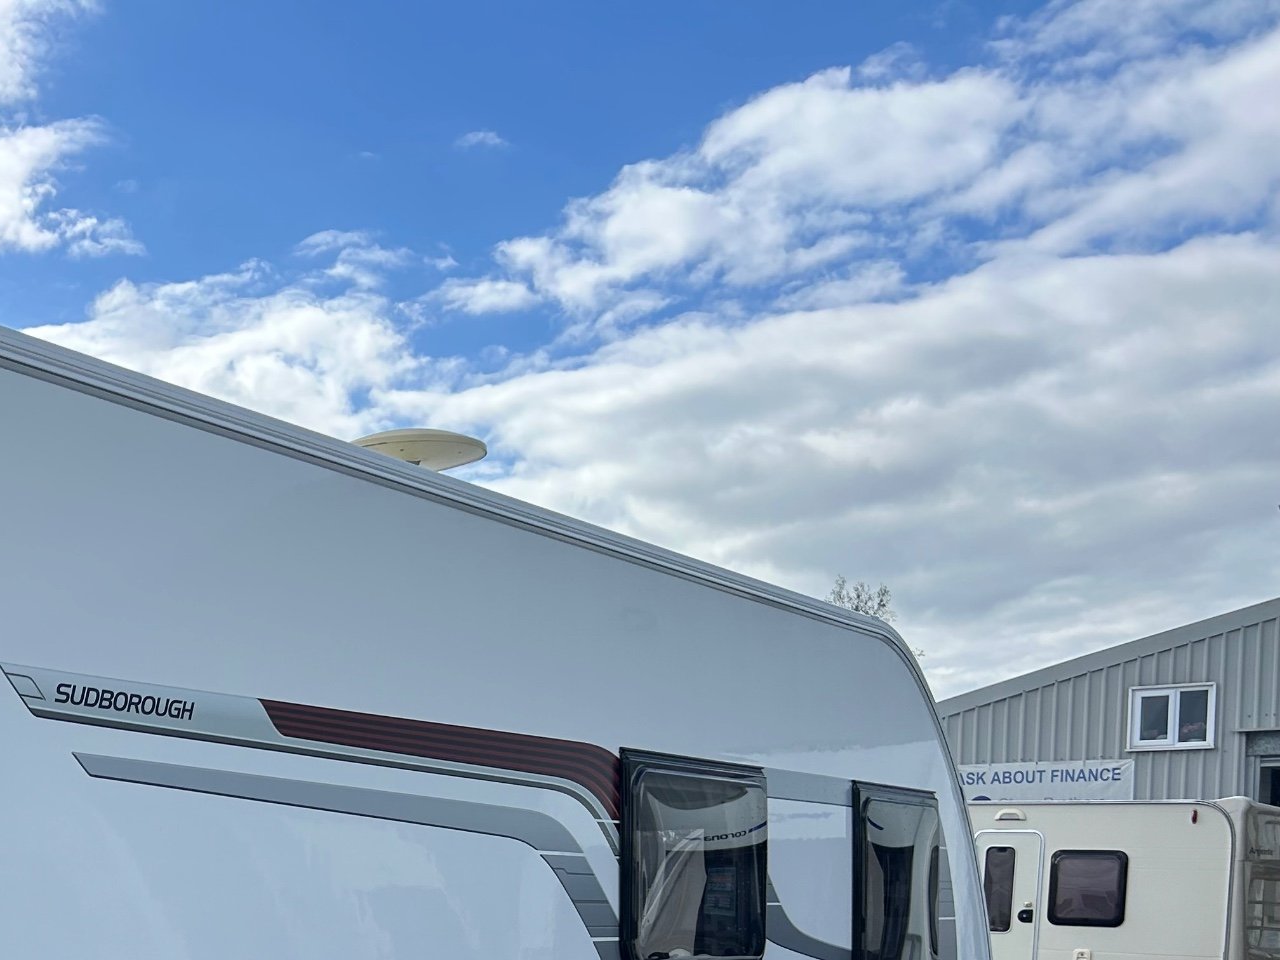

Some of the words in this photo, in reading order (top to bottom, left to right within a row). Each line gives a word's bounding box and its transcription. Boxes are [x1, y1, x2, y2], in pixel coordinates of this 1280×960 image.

[54, 683, 195, 720] SUDBOROUGH
[990, 770, 1045, 785] ABOUT
[1051, 767, 1122, 783] FINANCE
